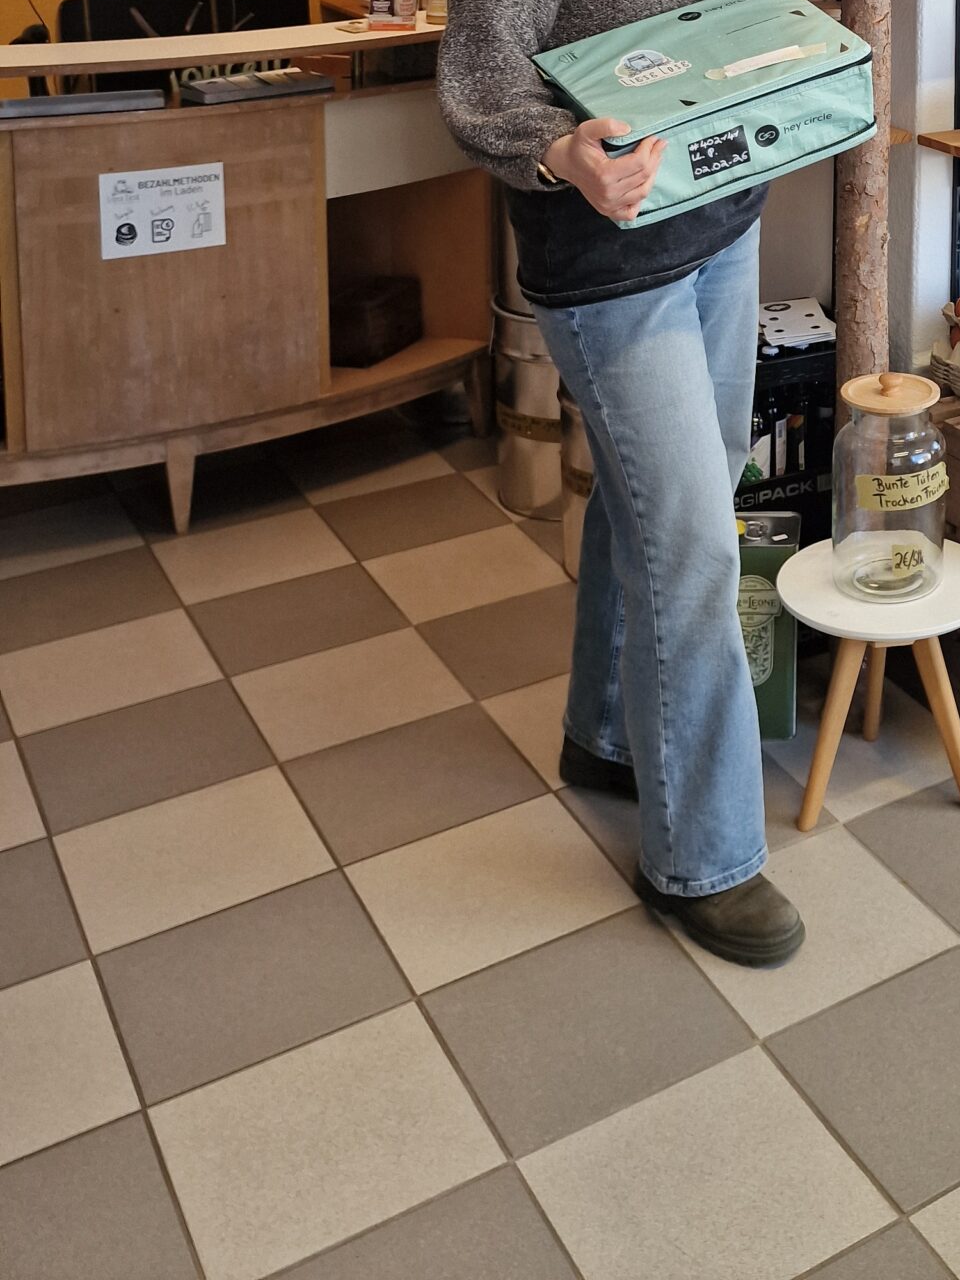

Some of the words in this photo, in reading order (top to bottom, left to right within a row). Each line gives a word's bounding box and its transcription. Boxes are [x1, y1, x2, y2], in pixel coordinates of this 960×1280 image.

[783, 121, 802, 135] hey
[804, 112, 833, 126] circle
[137, 174, 220, 190] BEZAHLMETHODEN
[174, 185, 204, 196] Laden
[872, 476, 910, 492] Bunte
[910, 471, 940, 487] Tüten
[872, 493, 923, 508] Trocken
[748, 595, 777, 610] LEONE
